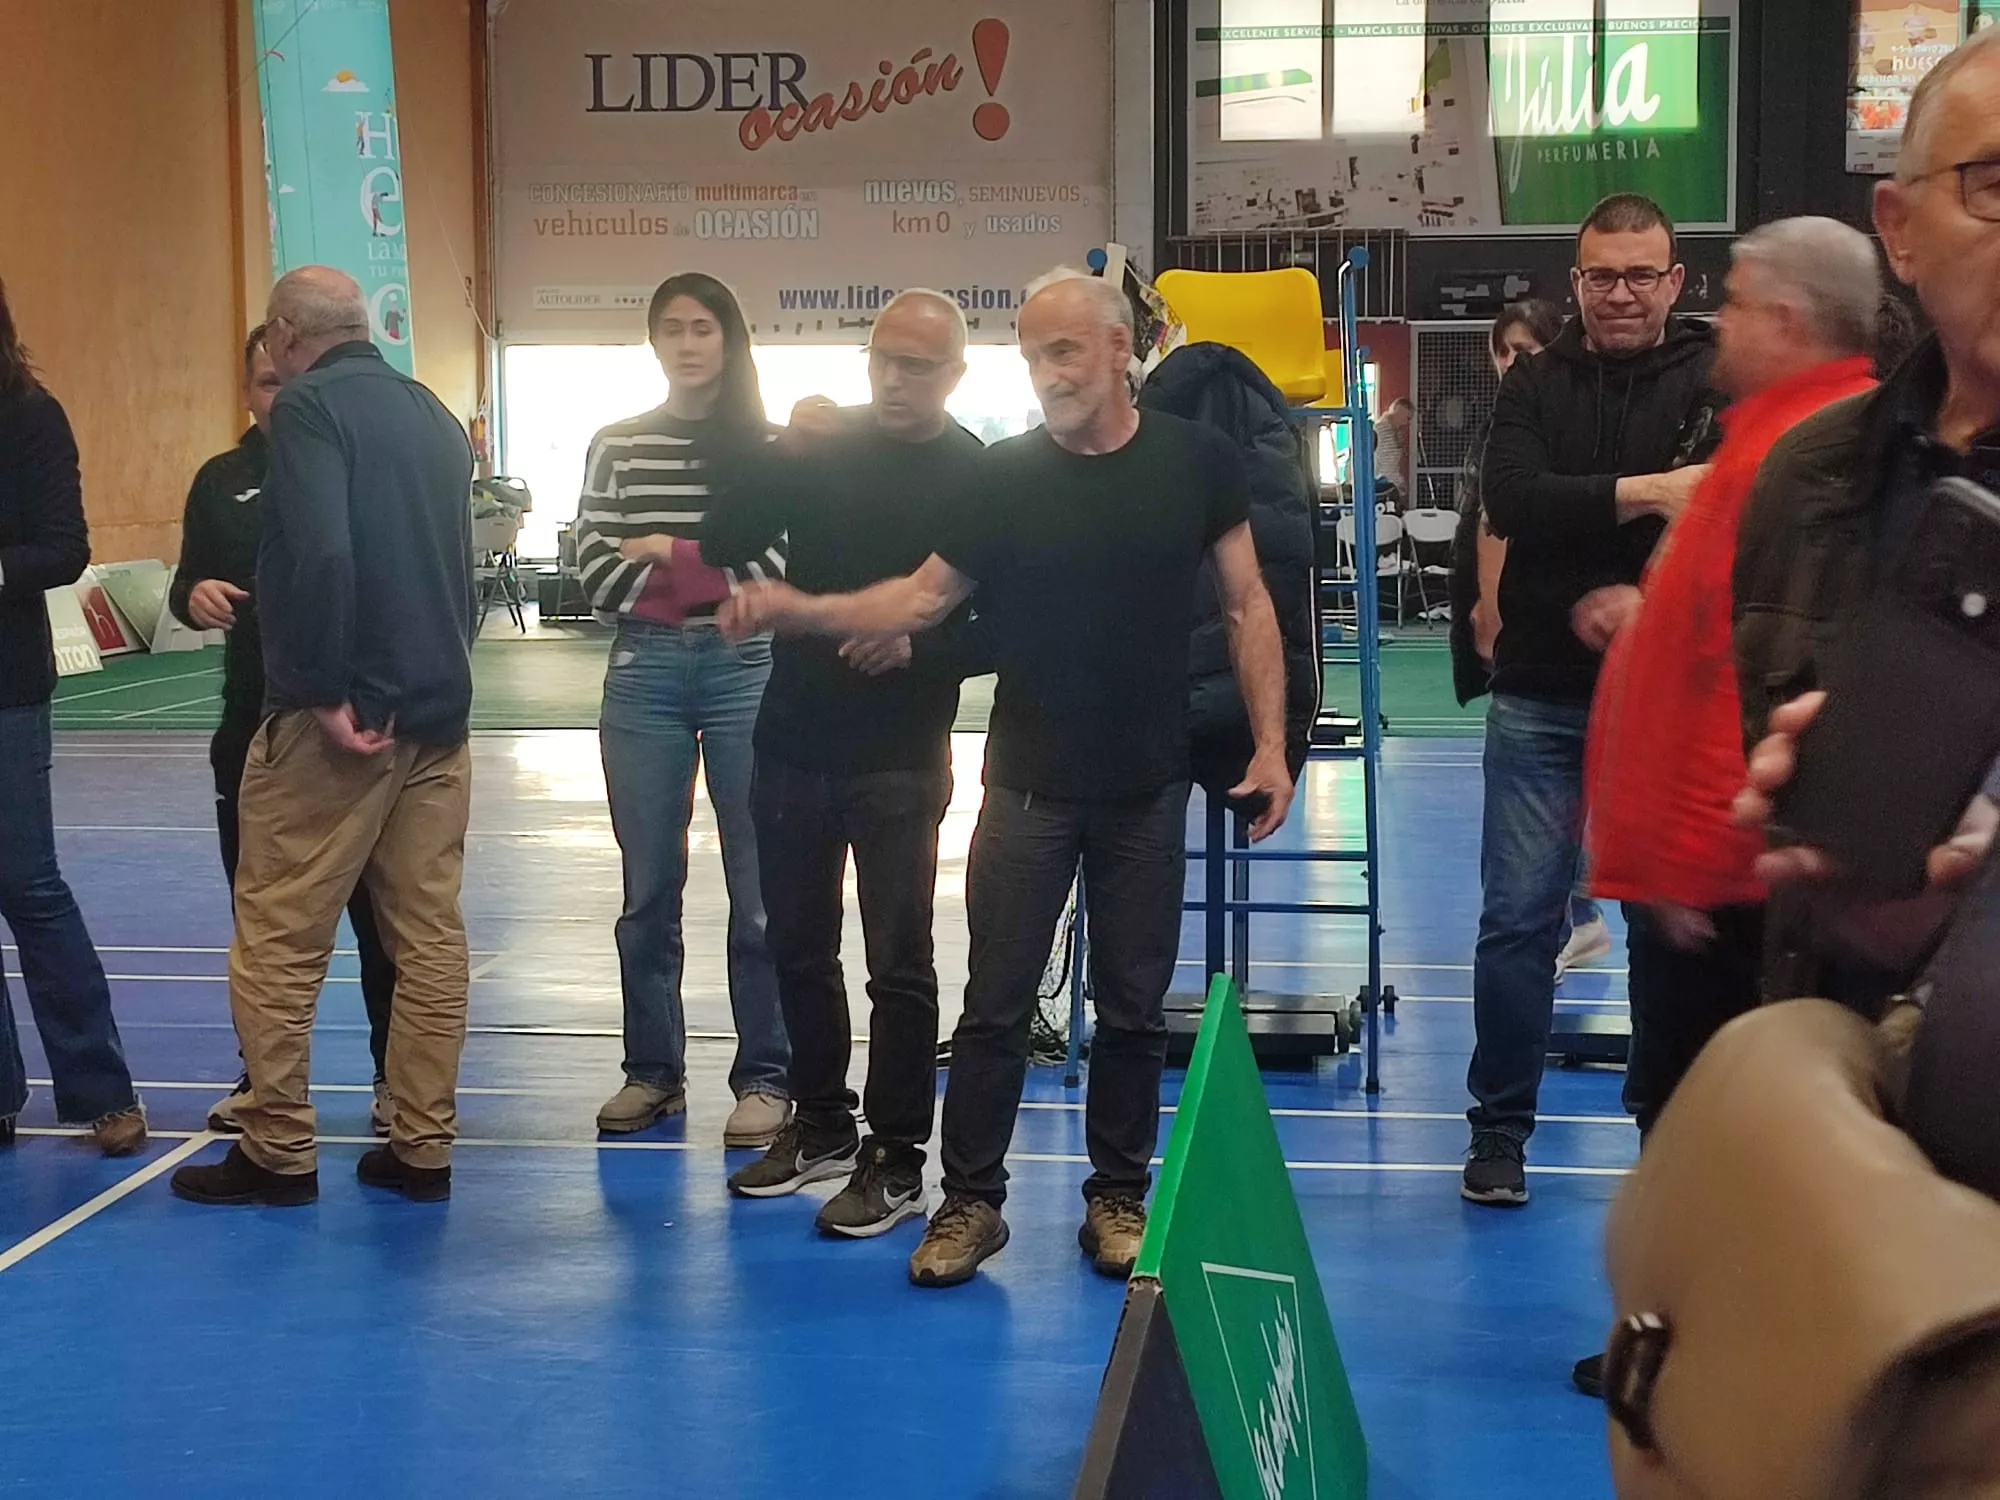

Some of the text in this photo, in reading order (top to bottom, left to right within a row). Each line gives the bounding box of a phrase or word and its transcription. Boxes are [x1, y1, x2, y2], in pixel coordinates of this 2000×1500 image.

[1347, 26, 1393, 36] MARCAS
[1397, 24, 1460, 35] SELECTIVAS
[1471, 23, 1525, 34] GRANDES
[1607, 20, 1656, 31] BUENOS
[1659, 18, 1709, 30] PRECIOS
[584, 52, 812, 113] LIDER
[1537, 138, 1661, 164] PERFUMERIA
[695, 183, 798, 201] multimarca
[695, 203, 819, 239] OCASIÓN
[893, 210, 931, 232] km
[964, 222, 976, 239] y
[985, 212, 1061, 233] usados
